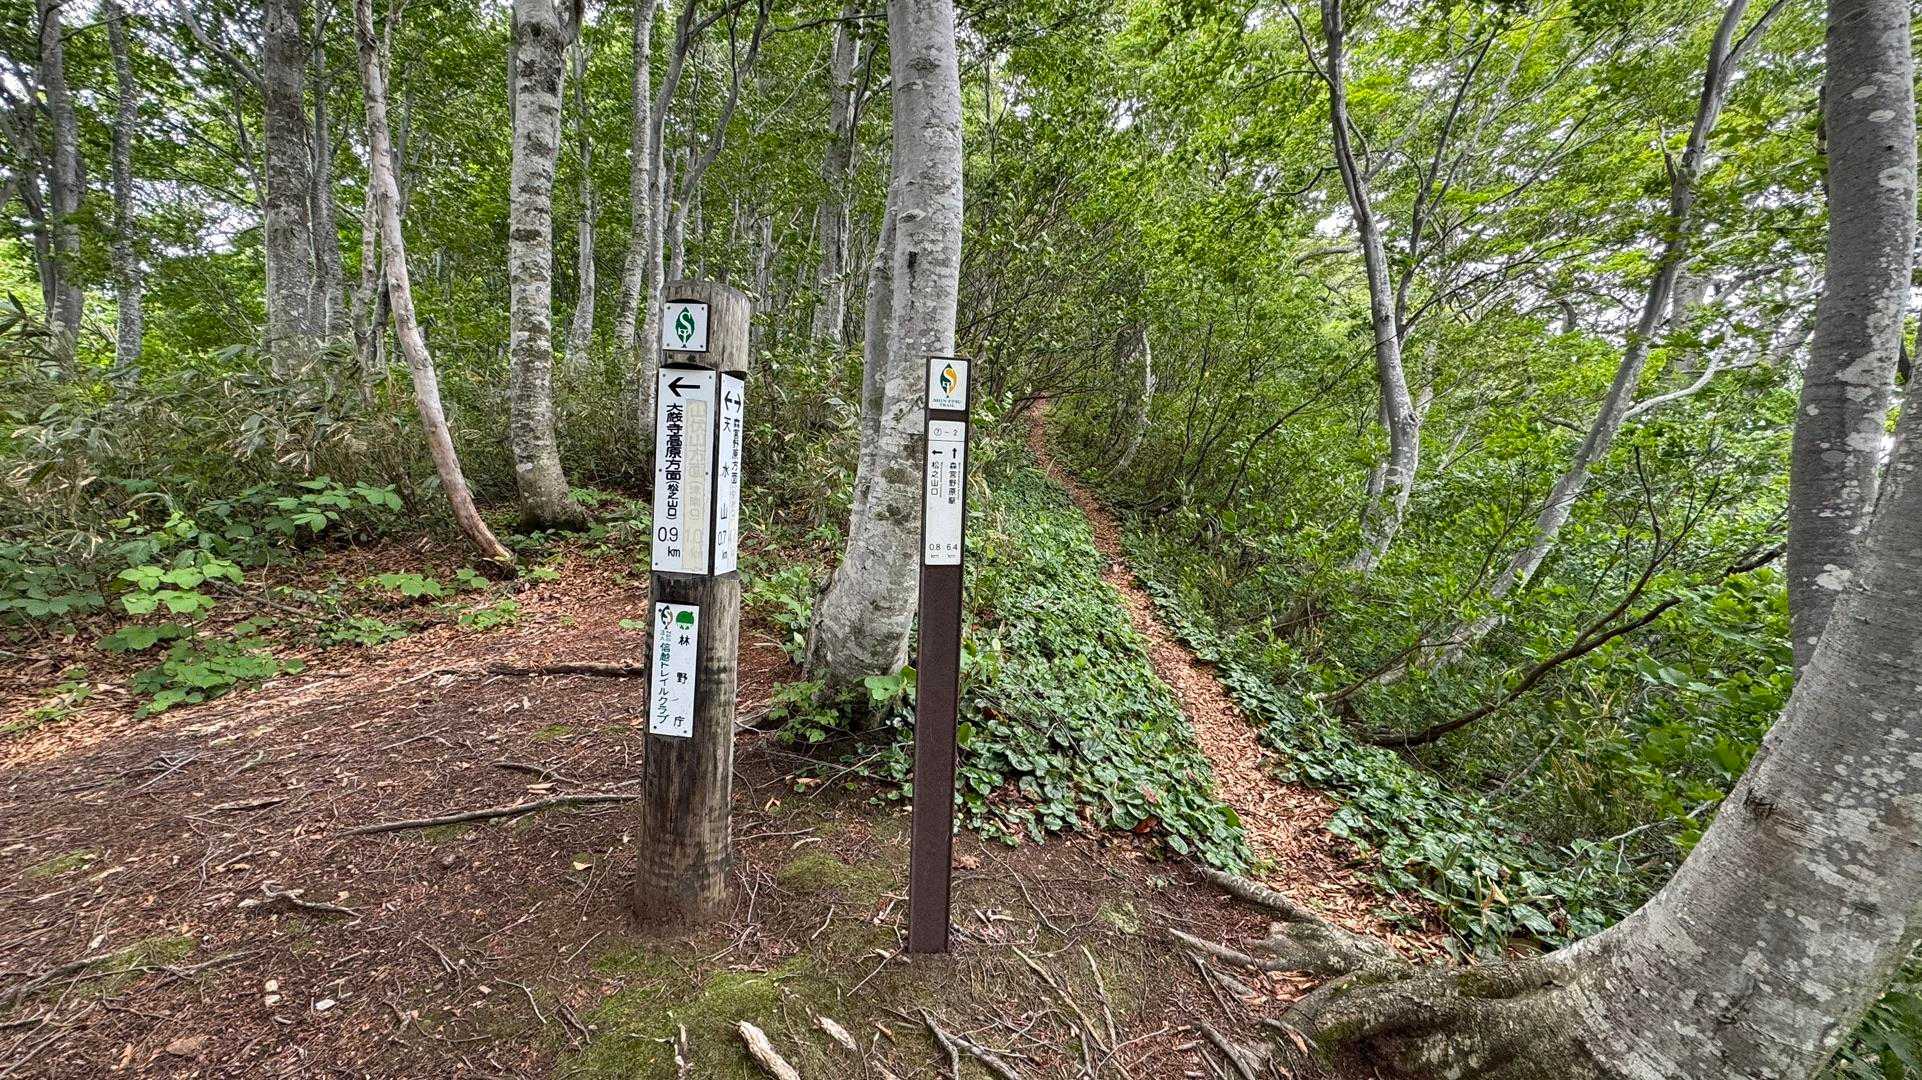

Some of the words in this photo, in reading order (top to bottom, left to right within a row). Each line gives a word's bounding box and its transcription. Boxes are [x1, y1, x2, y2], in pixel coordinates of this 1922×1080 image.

[720, 416, 731, 520] 天水山
[658, 526, 679, 542] 0.9
[667, 546, 681, 558] km
